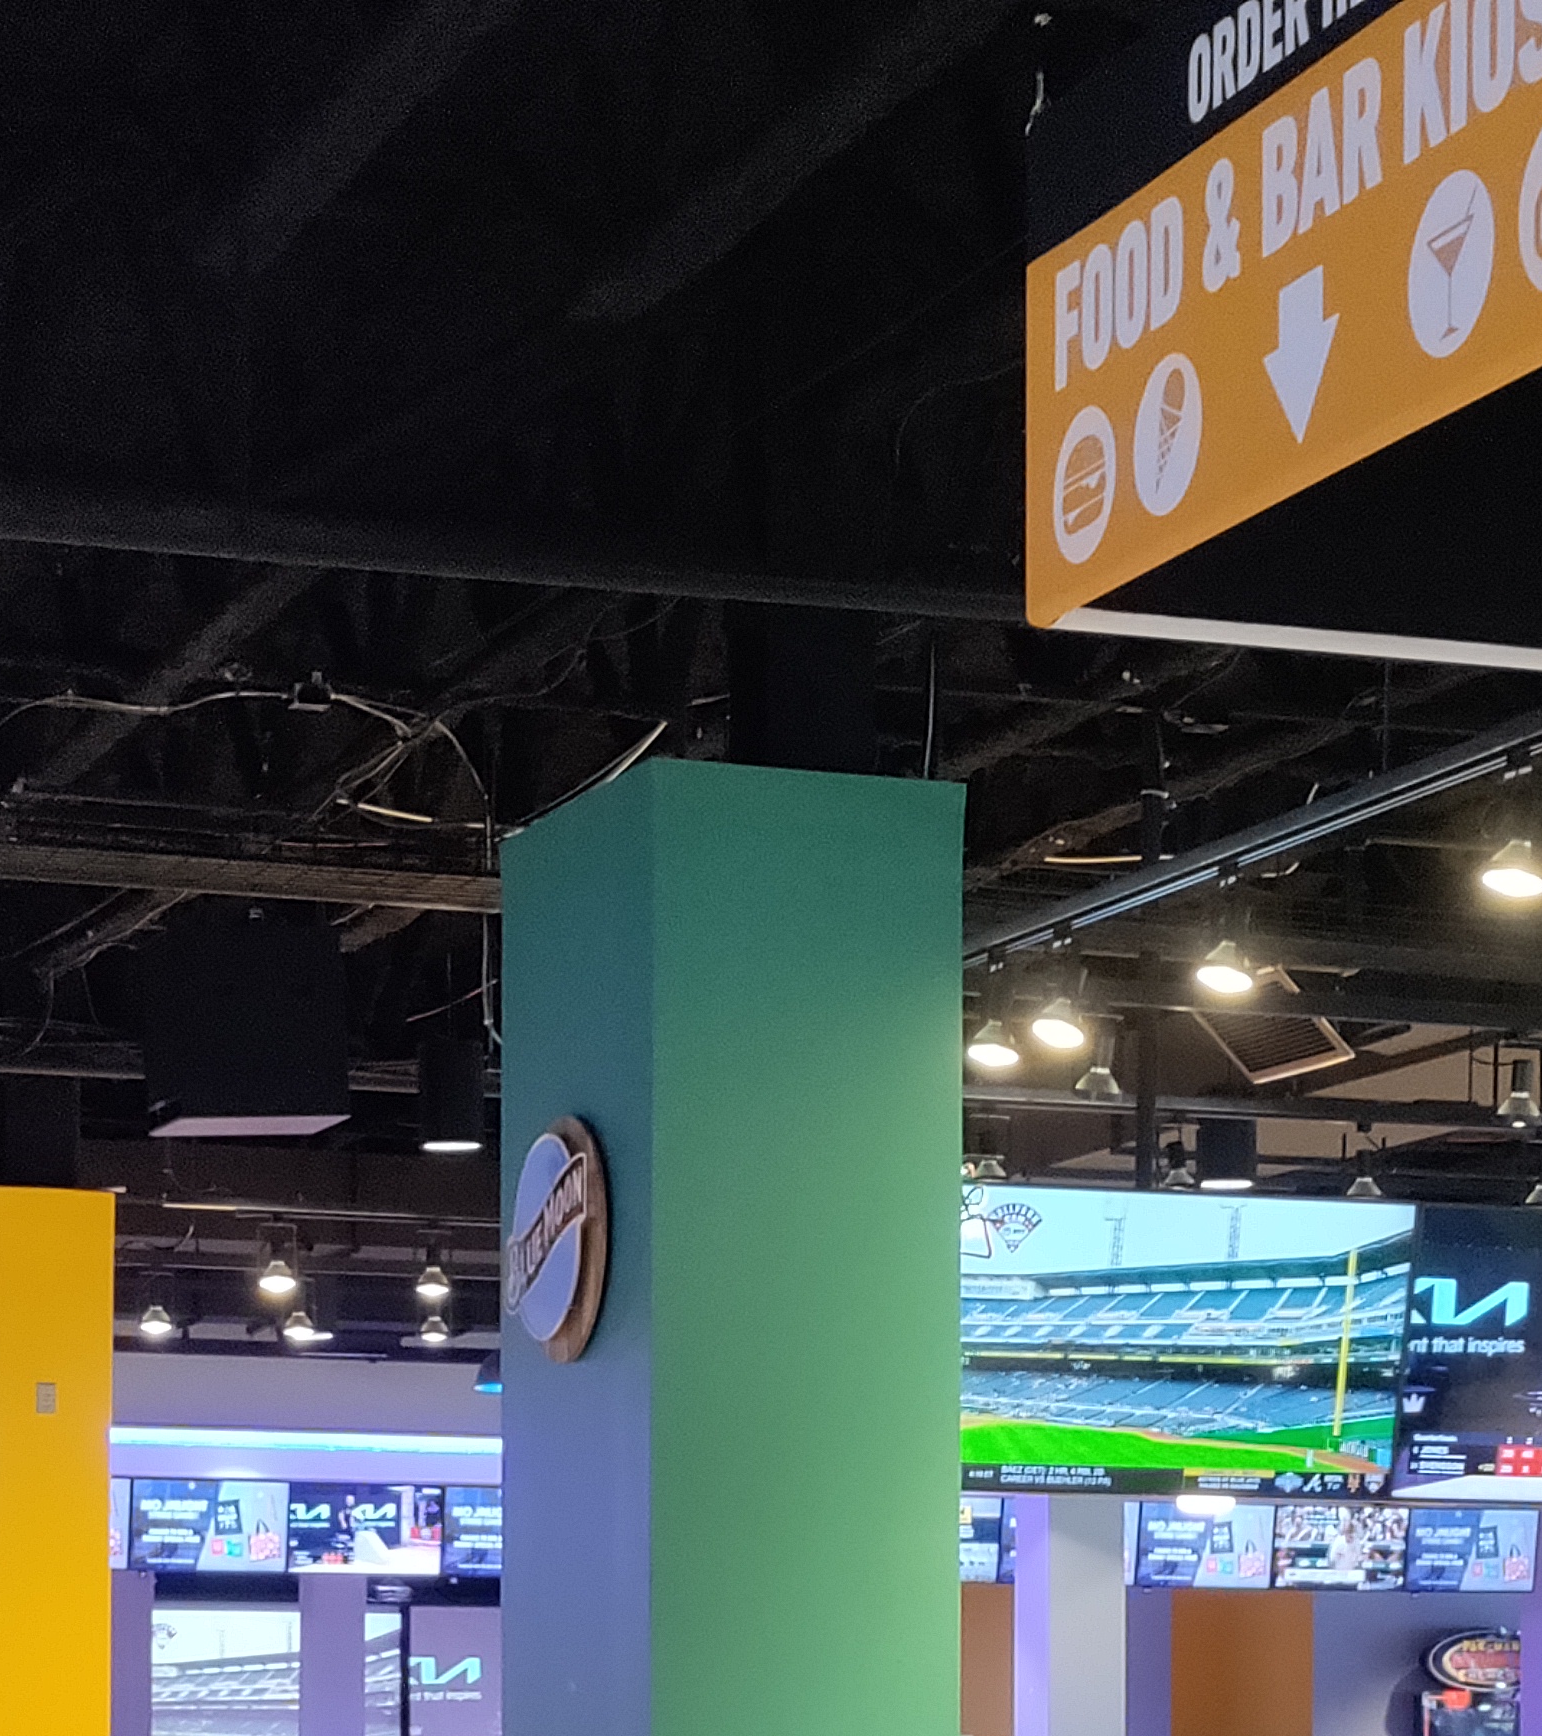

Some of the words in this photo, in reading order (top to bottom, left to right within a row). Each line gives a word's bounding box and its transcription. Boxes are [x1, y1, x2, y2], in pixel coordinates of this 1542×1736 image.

[1188, 0, 1309, 123] ORDER
[1055, 197, 1184, 393] FOOD
[1202, 158, 1241, 293] &
[1262, 57, 1383, 258] BAR
[1431, 1335, 1465, 1352] that
[1467, 1336, 1526, 1356] inspires
